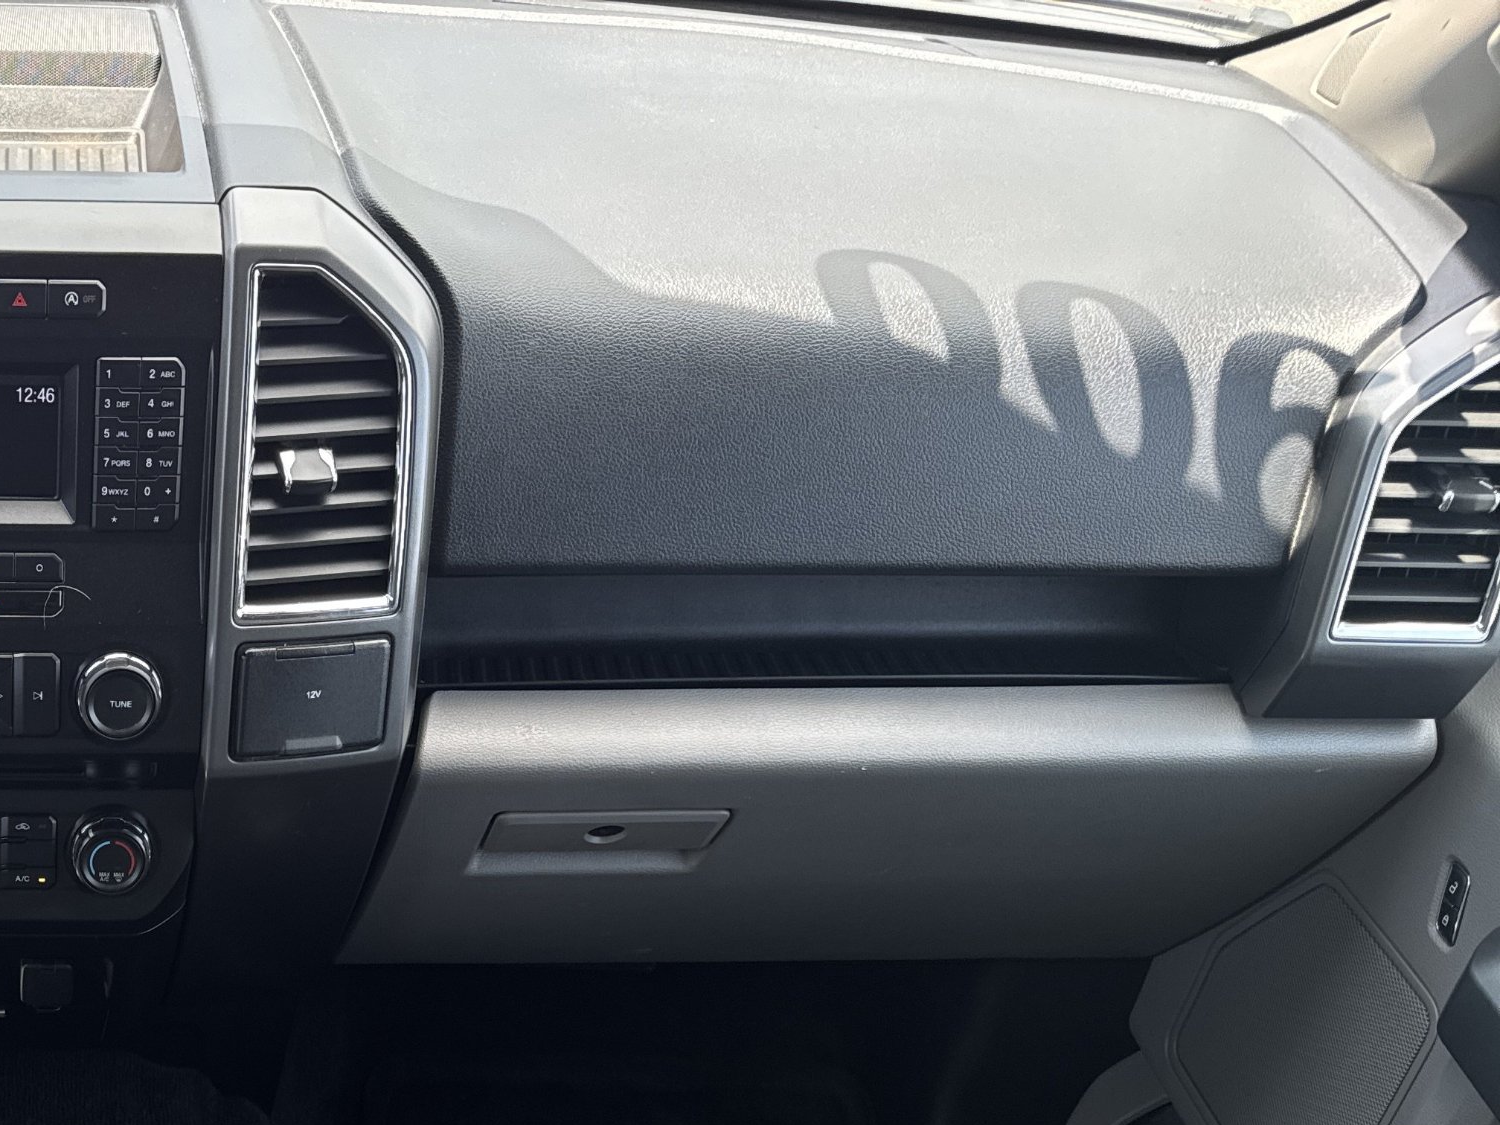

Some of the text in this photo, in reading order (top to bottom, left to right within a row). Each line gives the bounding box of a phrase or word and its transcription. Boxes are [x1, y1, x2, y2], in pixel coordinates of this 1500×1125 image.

[82, 295, 96, 303] OFF
[106, 368, 112, 379] 1
[148, 368, 156, 379] 2
[16, 387, 55, 403] 12:46
[104, 398, 110, 408] 3
[148, 398, 154, 408] 4
[104, 428, 110, 438] 5
[146, 428, 154, 438] 6
[103, 458, 110, 468] 7
[146, 458, 152, 468] 8
[102, 486, 108, 496] 9
[144, 486, 150, 496] 0
[306, 690, 322, 698] 12V
[110, 700, 132, 709] TUNE
